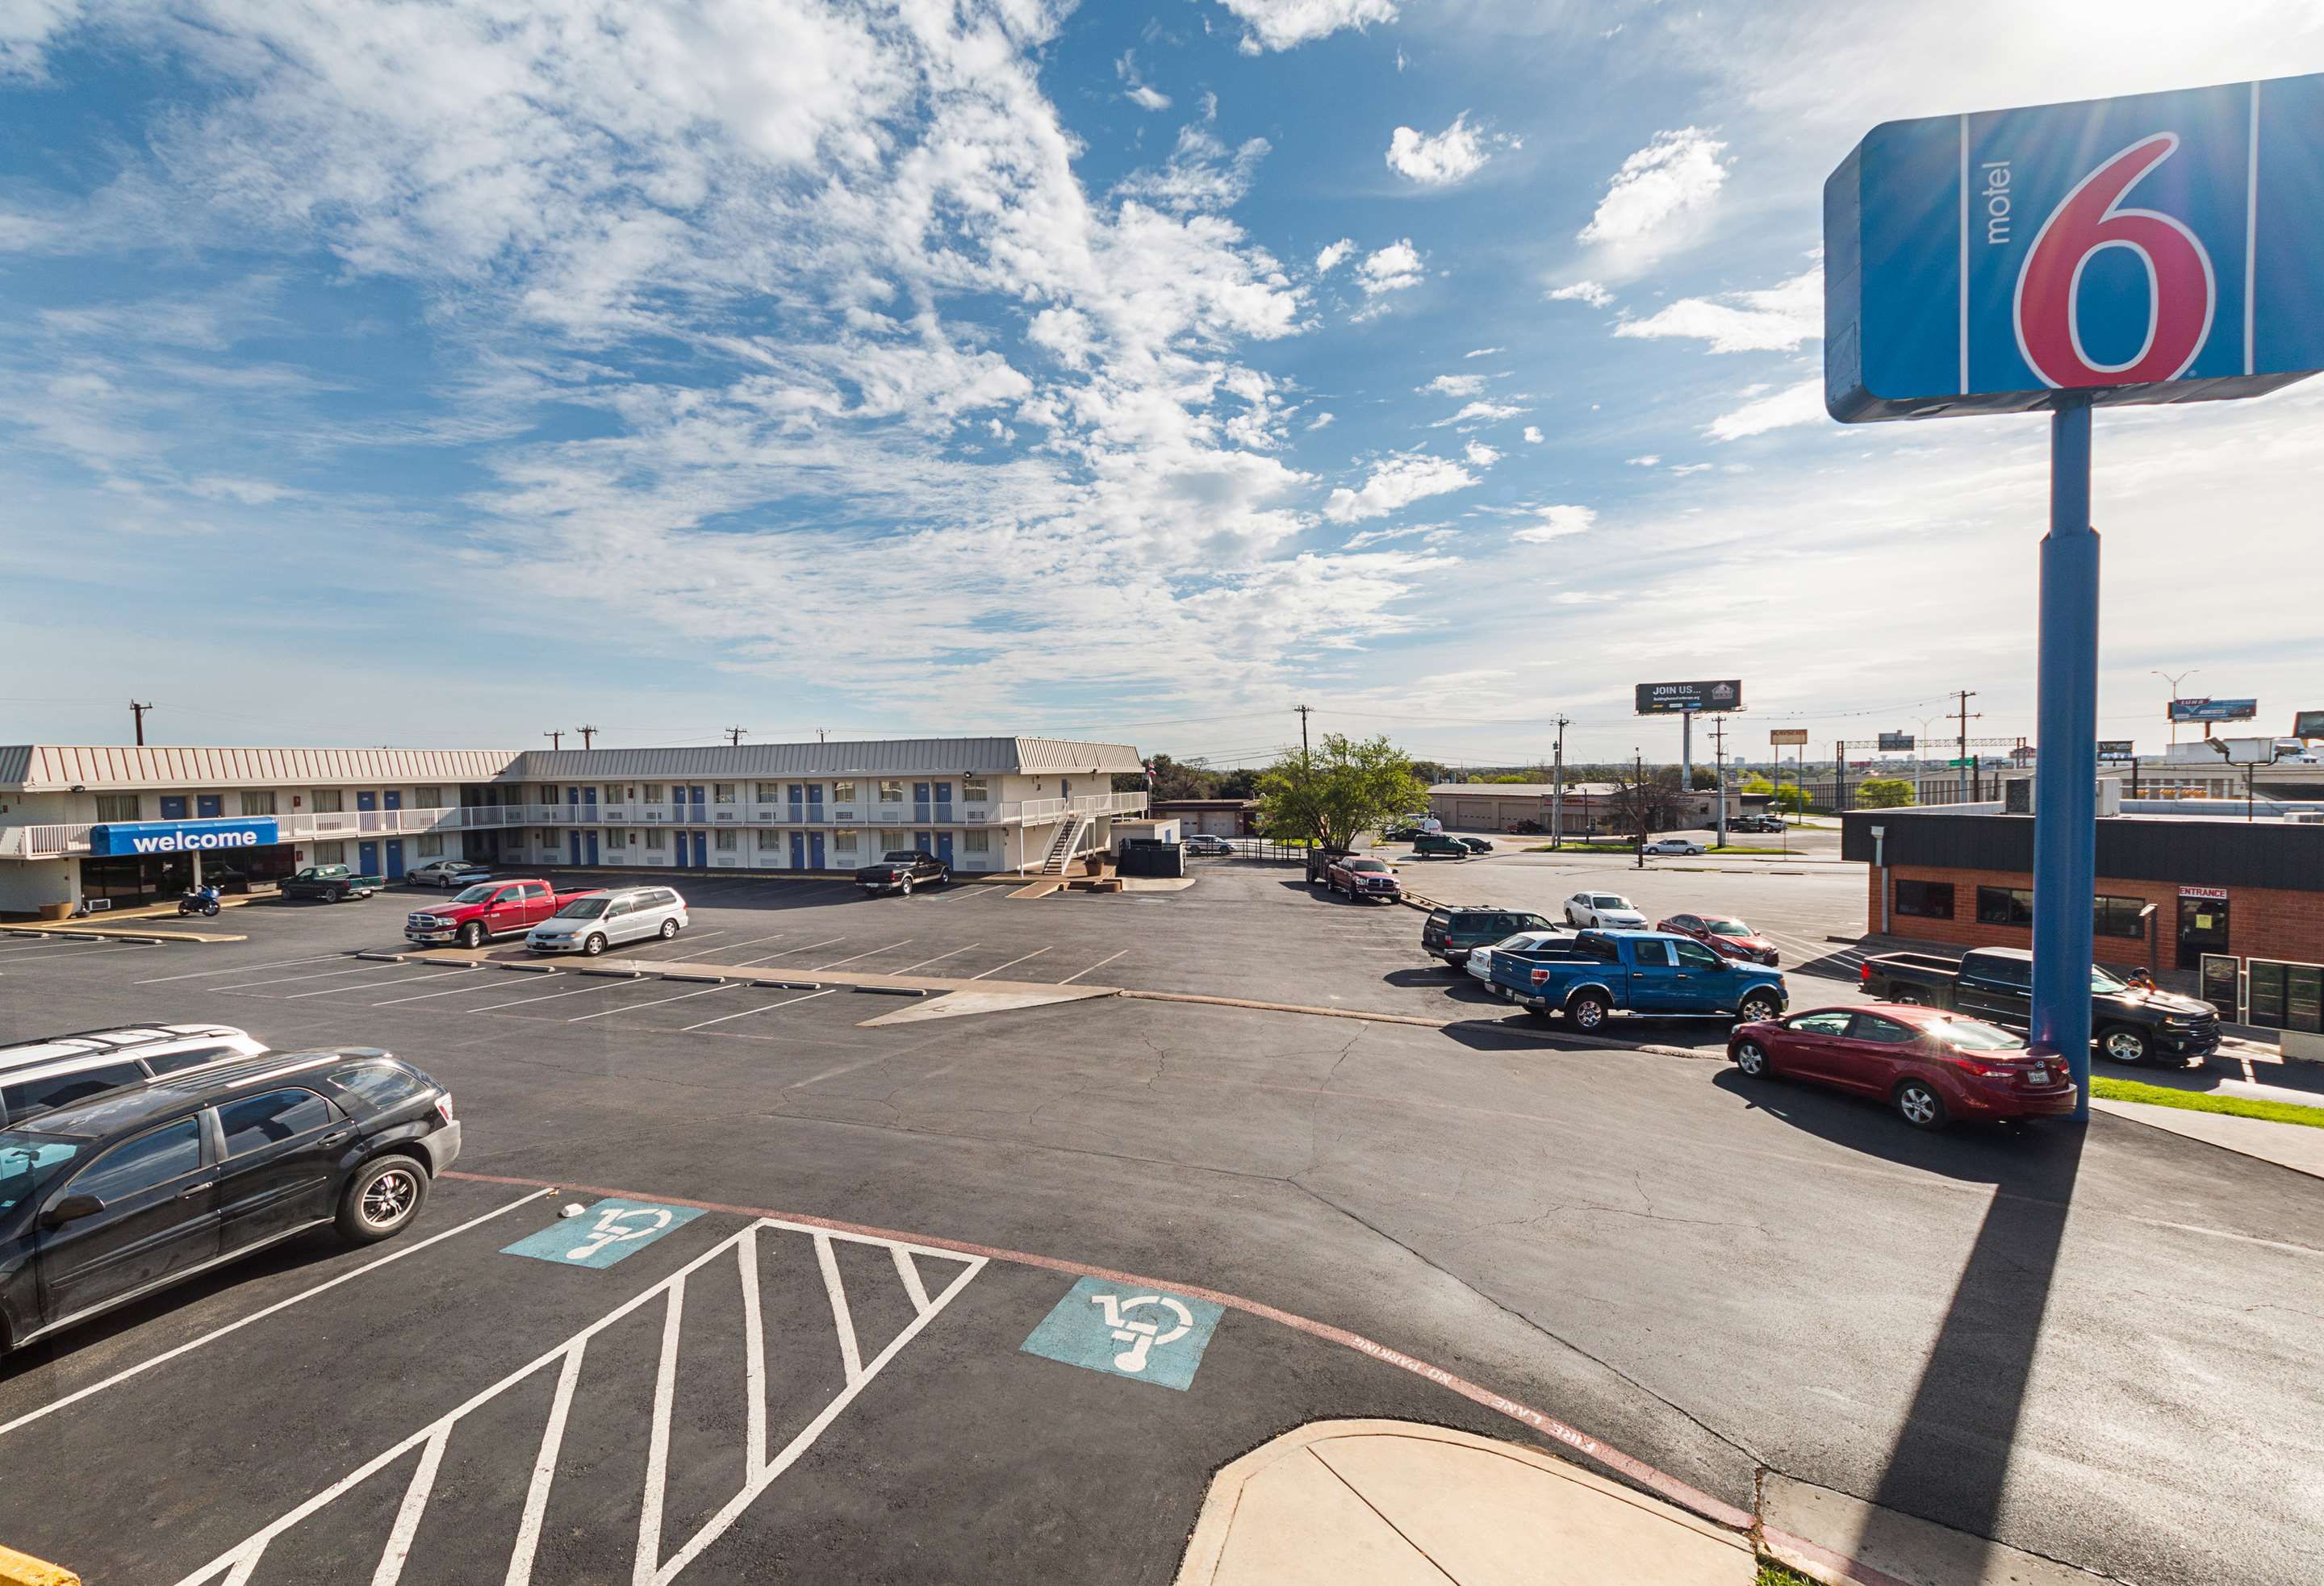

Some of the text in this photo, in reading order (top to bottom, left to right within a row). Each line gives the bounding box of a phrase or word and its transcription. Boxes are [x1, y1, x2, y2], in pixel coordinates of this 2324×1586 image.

[1981, 161, 2011, 245] motel
[2013, 131, 2217, 390] 6
[1653, 686, 1677, 695] JOIN
[1678, 685, 1702, 695] US...
[132, 830, 257, 853] welcome
[2180, 887, 2226, 898] ENTRANCE
[1353, 1336, 1596, 1453] FIRE LANE NO PARKING
